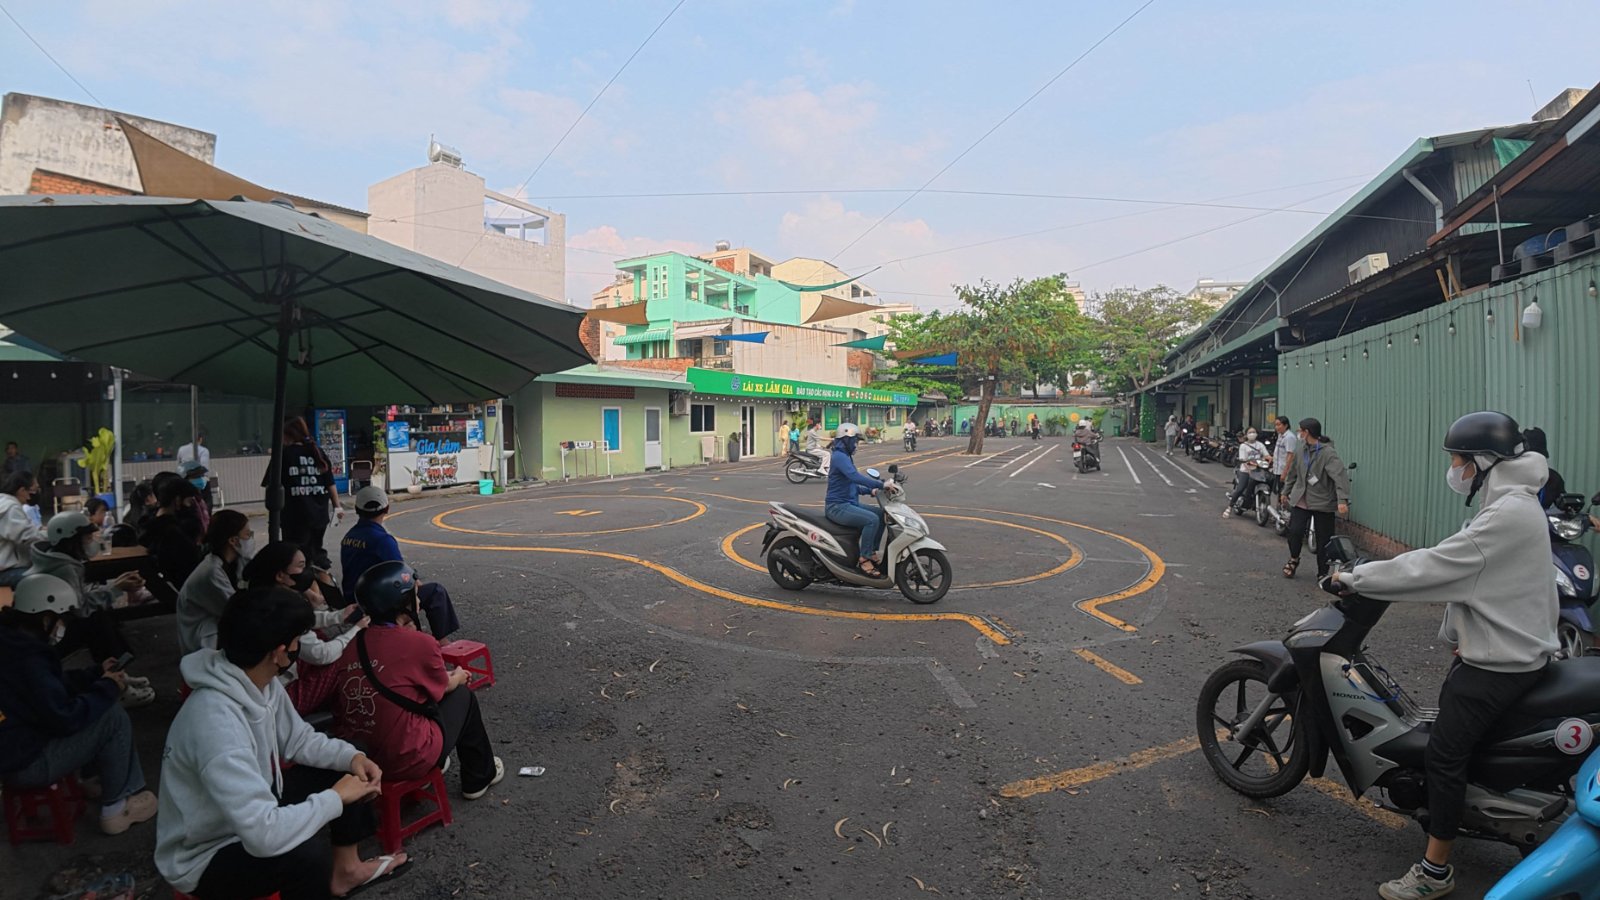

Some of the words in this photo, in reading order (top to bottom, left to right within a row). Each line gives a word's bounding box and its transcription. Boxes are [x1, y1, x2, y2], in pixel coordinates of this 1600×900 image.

[743, 380, 754, 391] LÁI
[755, 383, 763, 392] XE
[782, 384, 793, 394] GIA
[437, 438, 461, 455] Lâm
[1578, 567, 1585, 577] 5
[1332, 691, 1366, 700] HONDA
[1564, 725, 1582, 749] 3
